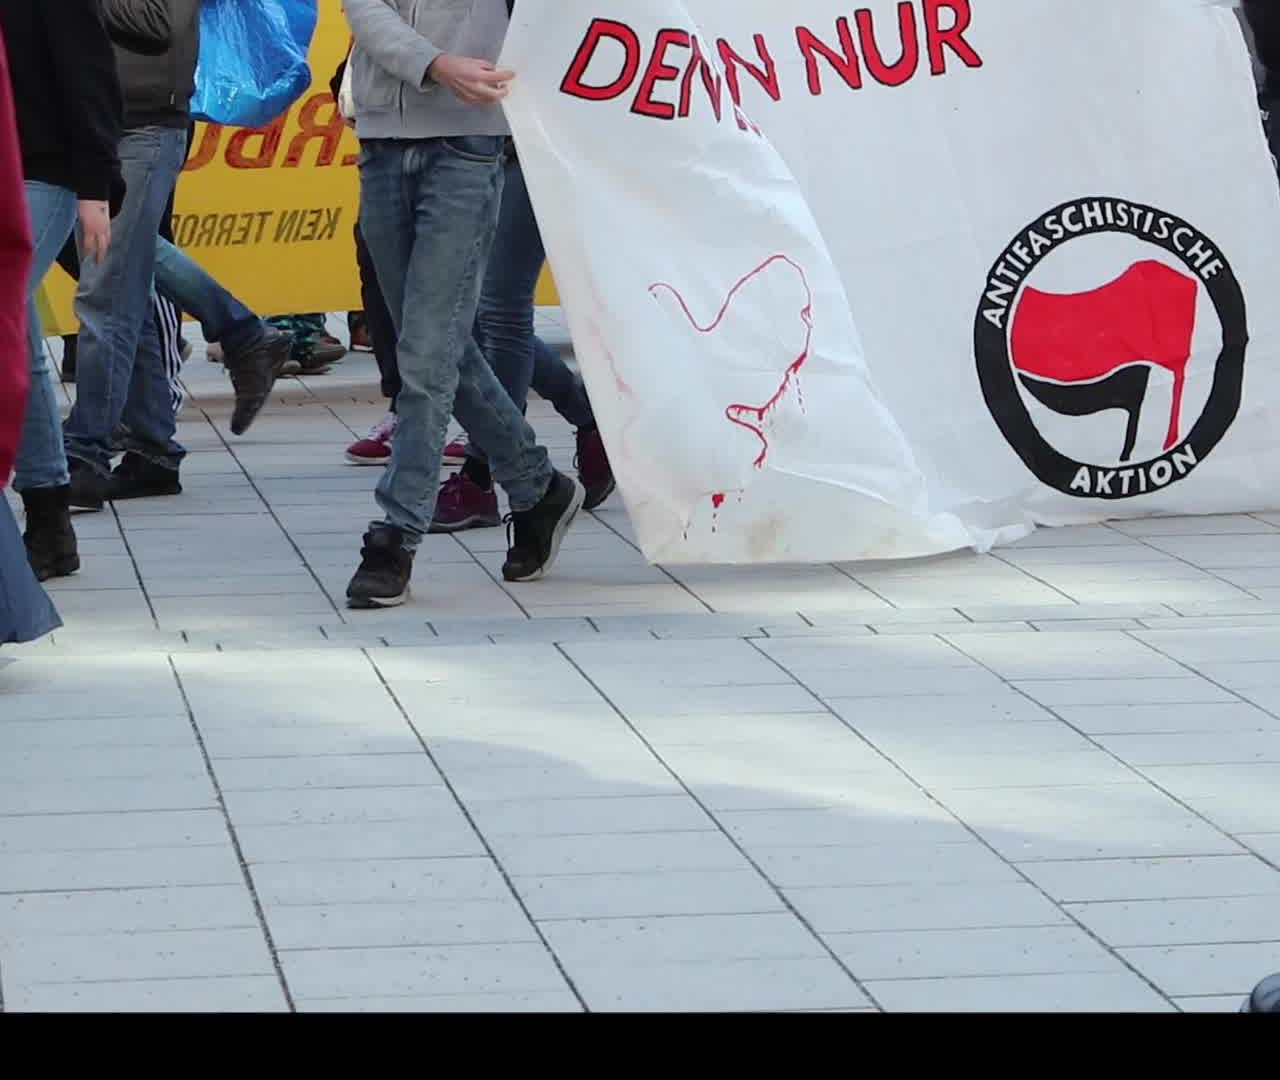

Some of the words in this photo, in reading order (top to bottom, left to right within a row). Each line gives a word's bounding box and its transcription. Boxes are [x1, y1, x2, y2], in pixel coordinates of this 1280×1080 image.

[559, 17, 782, 131] DENN
[982, 200, 1224, 328] ANTIFASCHISTISCHE
[1069, 442, 1199, 495] AKTION
